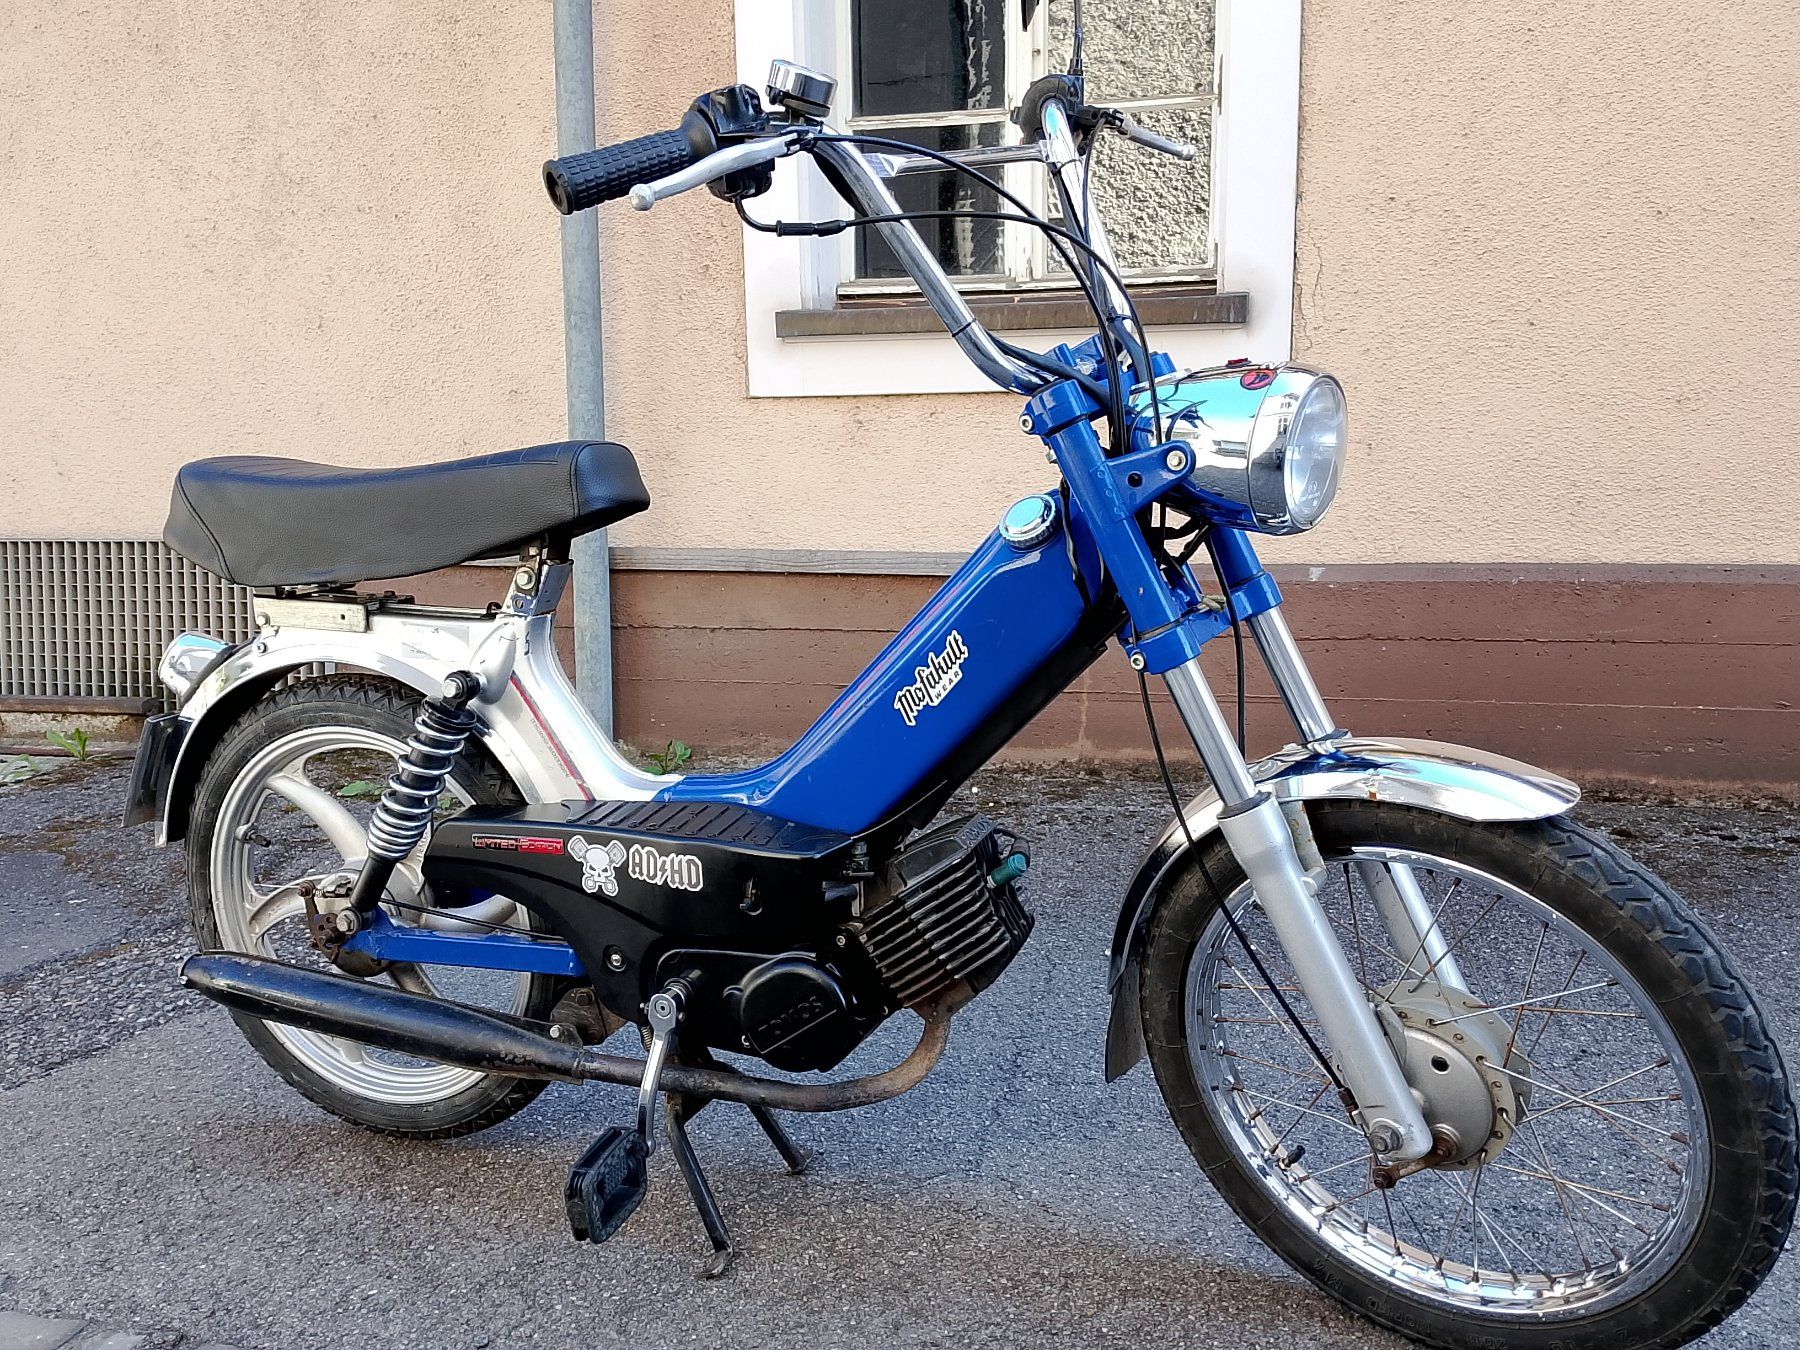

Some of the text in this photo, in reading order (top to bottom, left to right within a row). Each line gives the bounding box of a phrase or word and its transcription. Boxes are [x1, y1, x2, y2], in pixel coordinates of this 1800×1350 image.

[934, 670, 960, 700] WEAR
[475, 837, 562, 850] LIMITED EDITION
